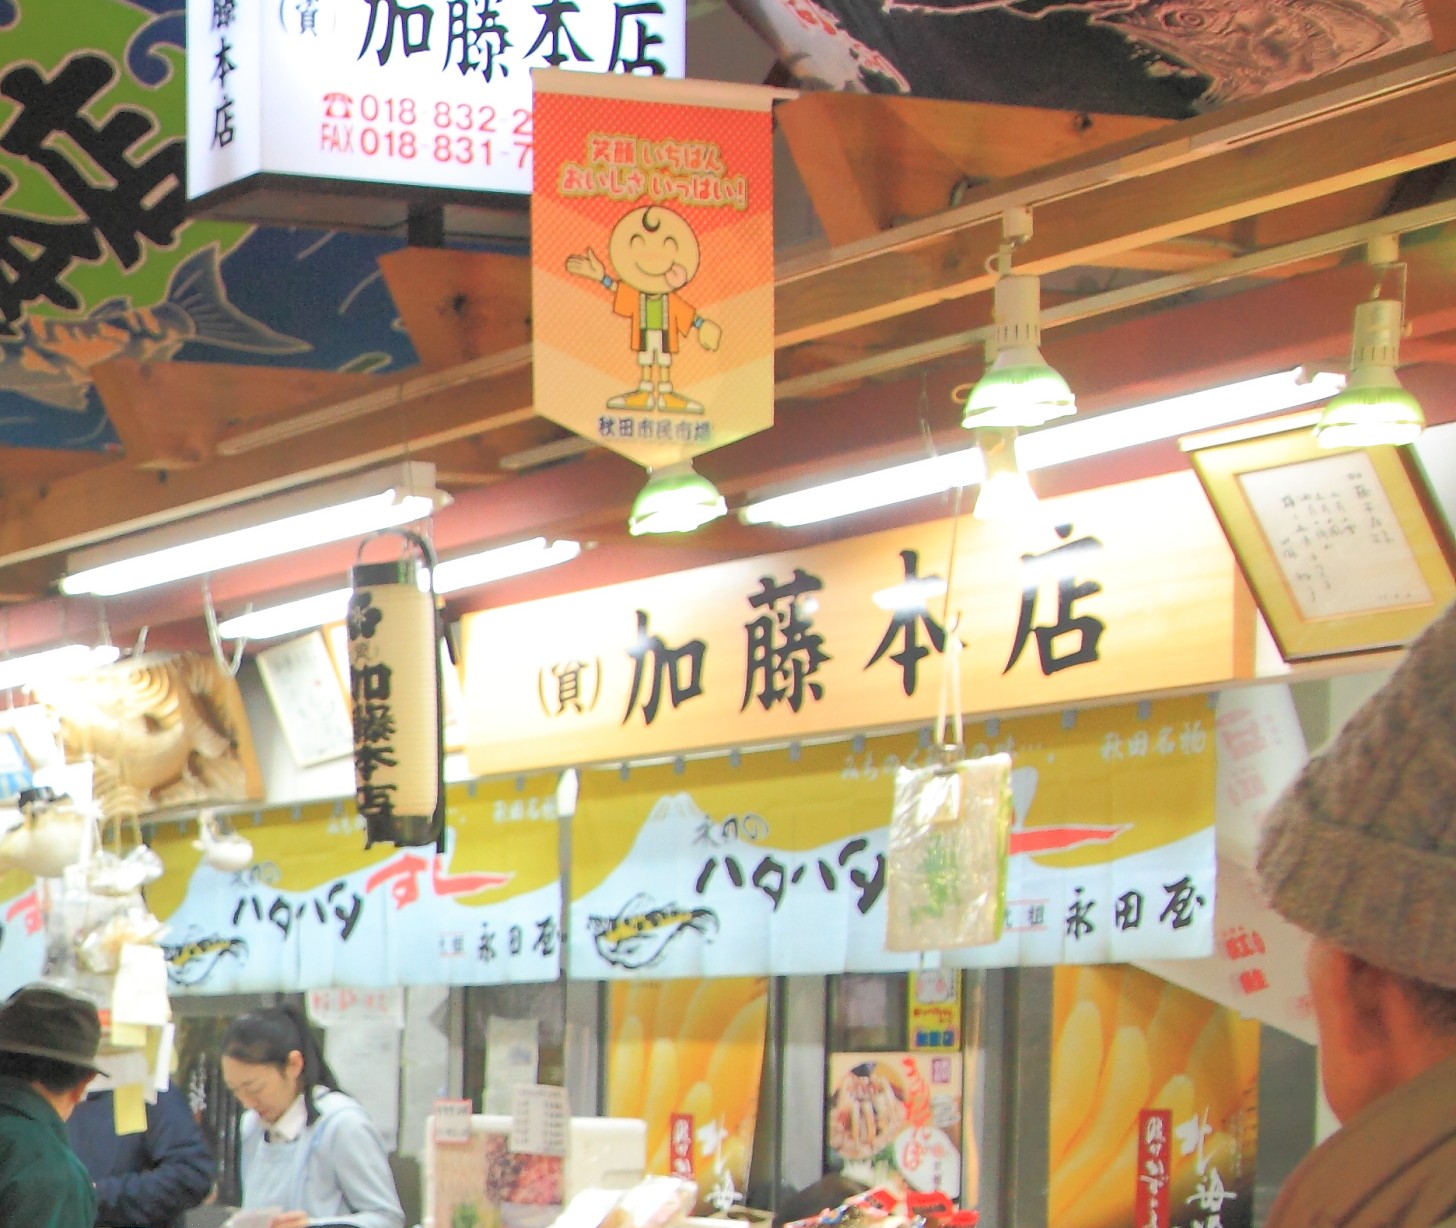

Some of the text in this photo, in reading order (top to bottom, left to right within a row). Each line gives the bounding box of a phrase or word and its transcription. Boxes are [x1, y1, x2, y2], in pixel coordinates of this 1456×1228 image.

[321, 122, 355, 153] FAX
[589, 134, 727, 176] 笑顔 いちばん
[560, 164, 644, 200] おいしさ
[596, 415, 714, 444] 秋田市民市場
[694, 837, 886, 915] ハタハタ
[232, 880, 365, 942] ハタハタ
